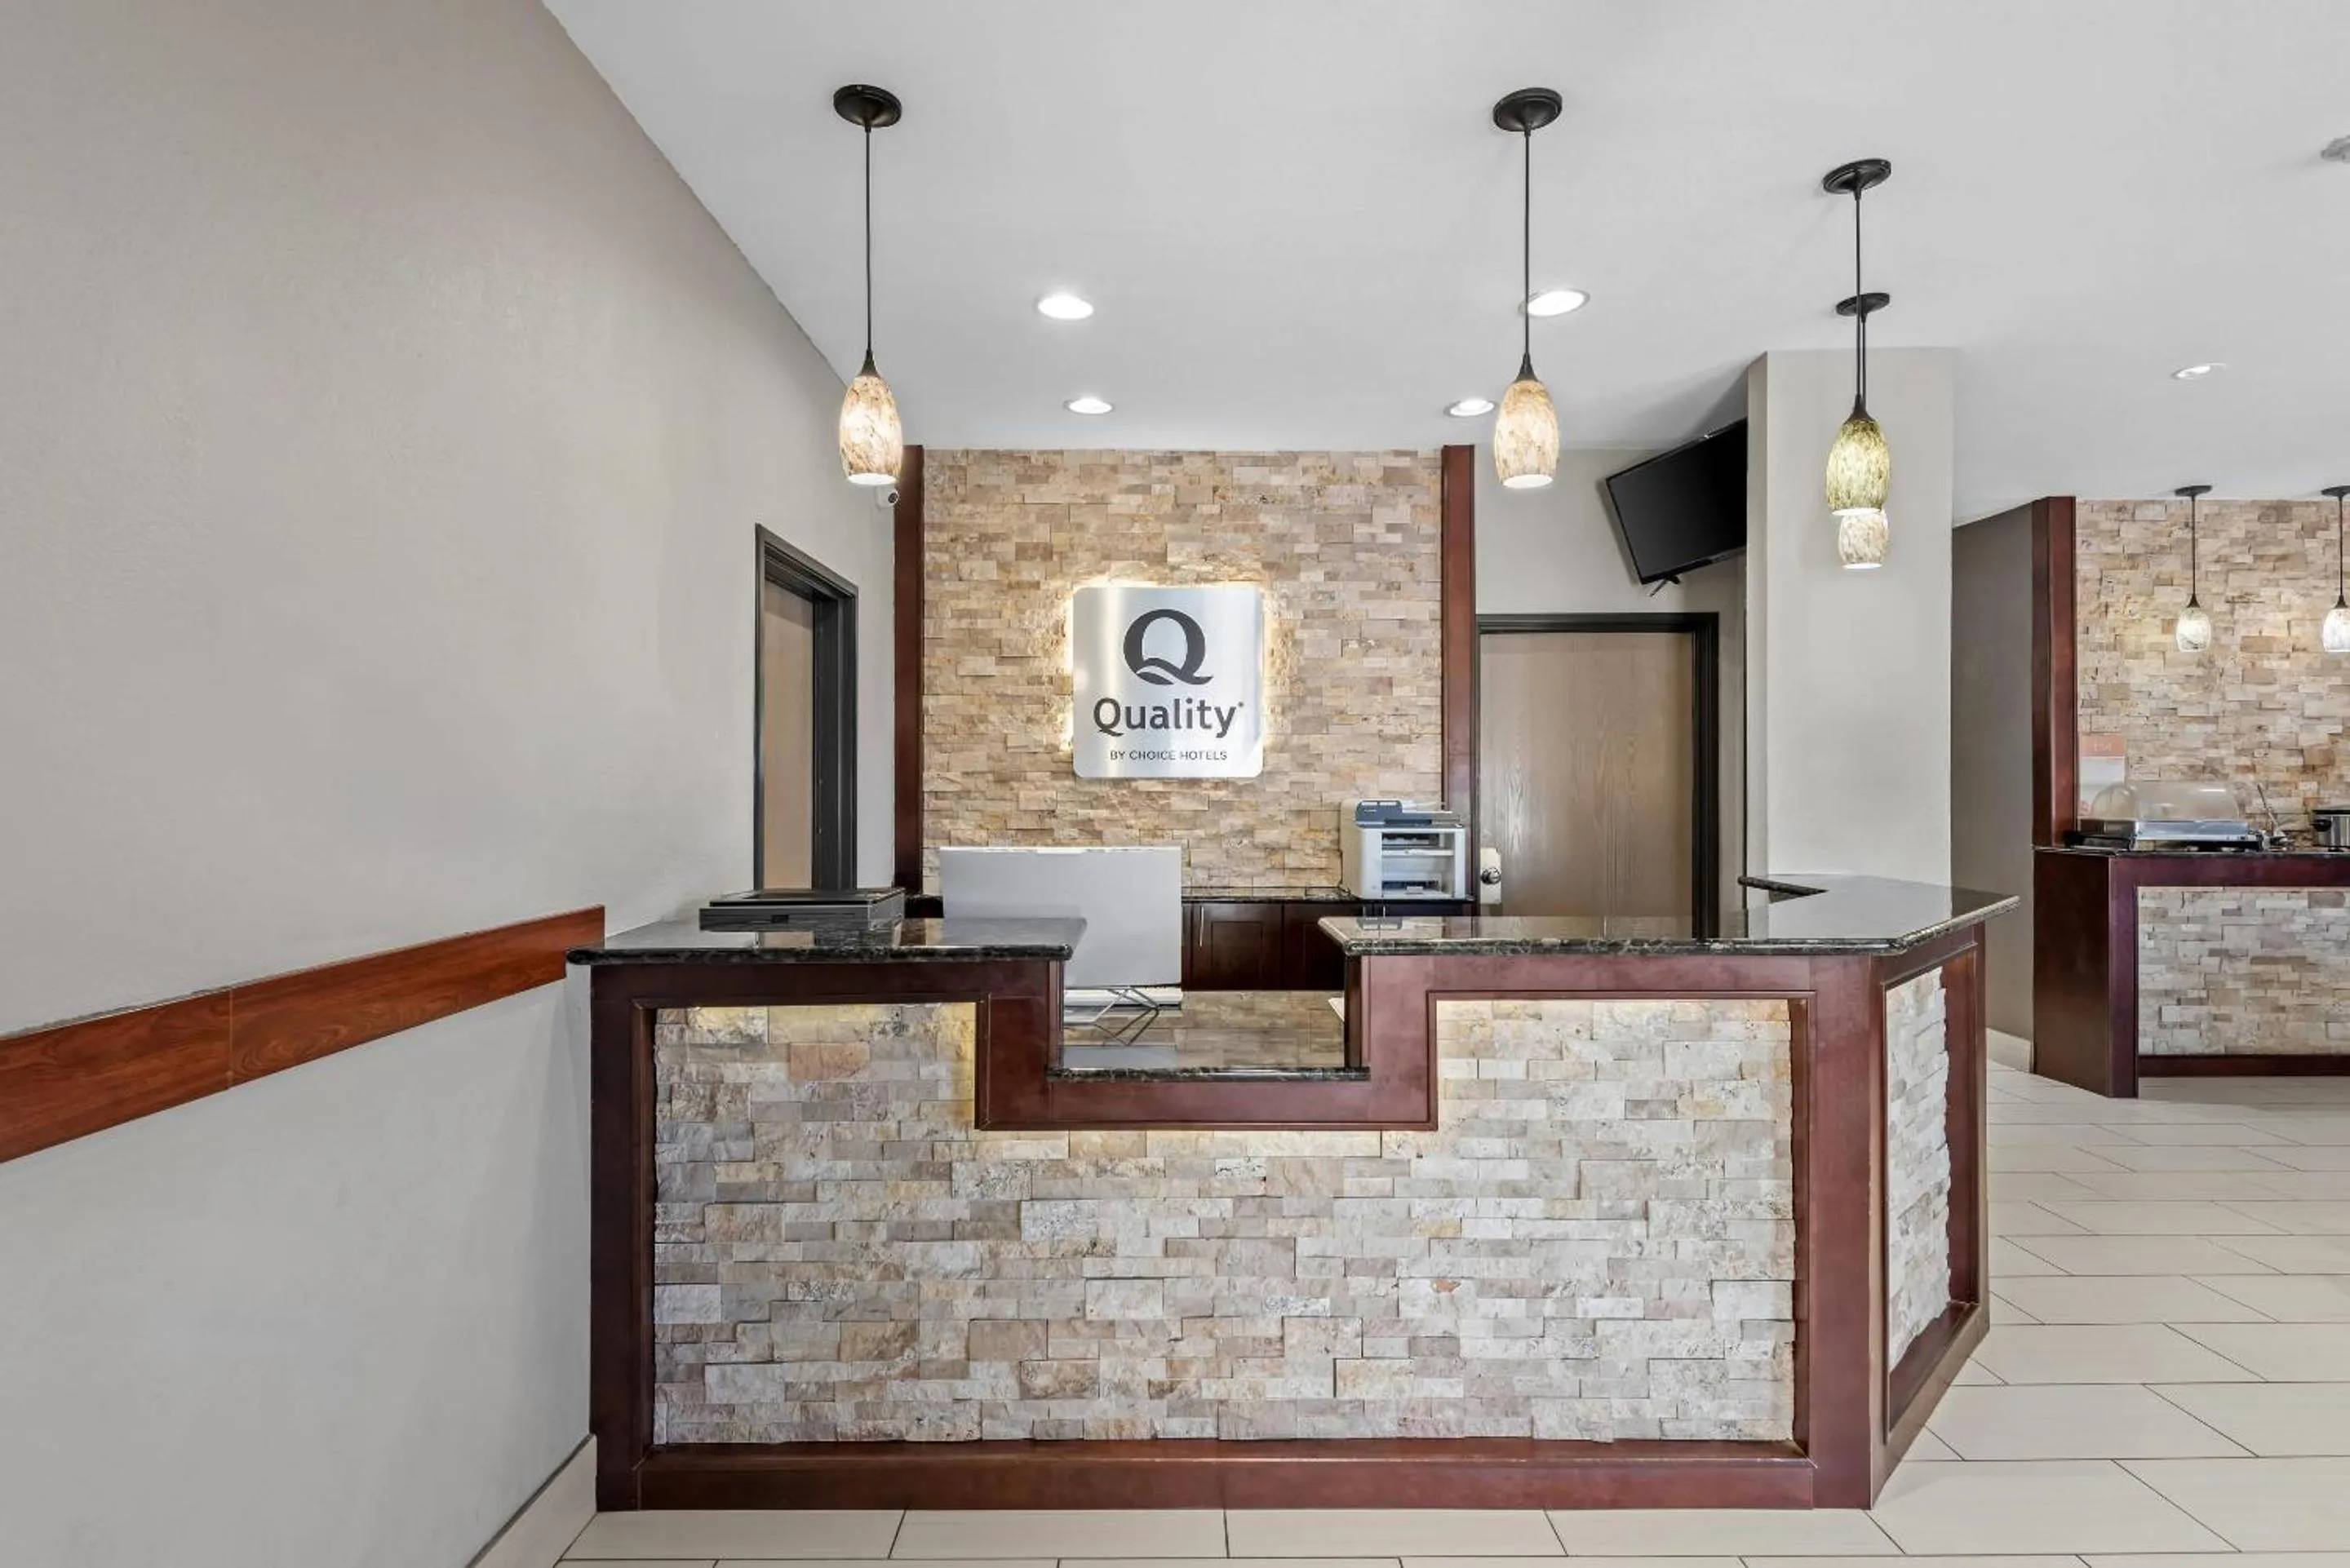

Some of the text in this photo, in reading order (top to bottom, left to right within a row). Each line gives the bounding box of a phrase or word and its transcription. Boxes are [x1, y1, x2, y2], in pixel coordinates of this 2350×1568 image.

[1124, 609, 1213, 685] Q
[1093, 698, 1238, 738] Quality
[1110, 750, 1227, 760] BY CHOICE HOTELS
